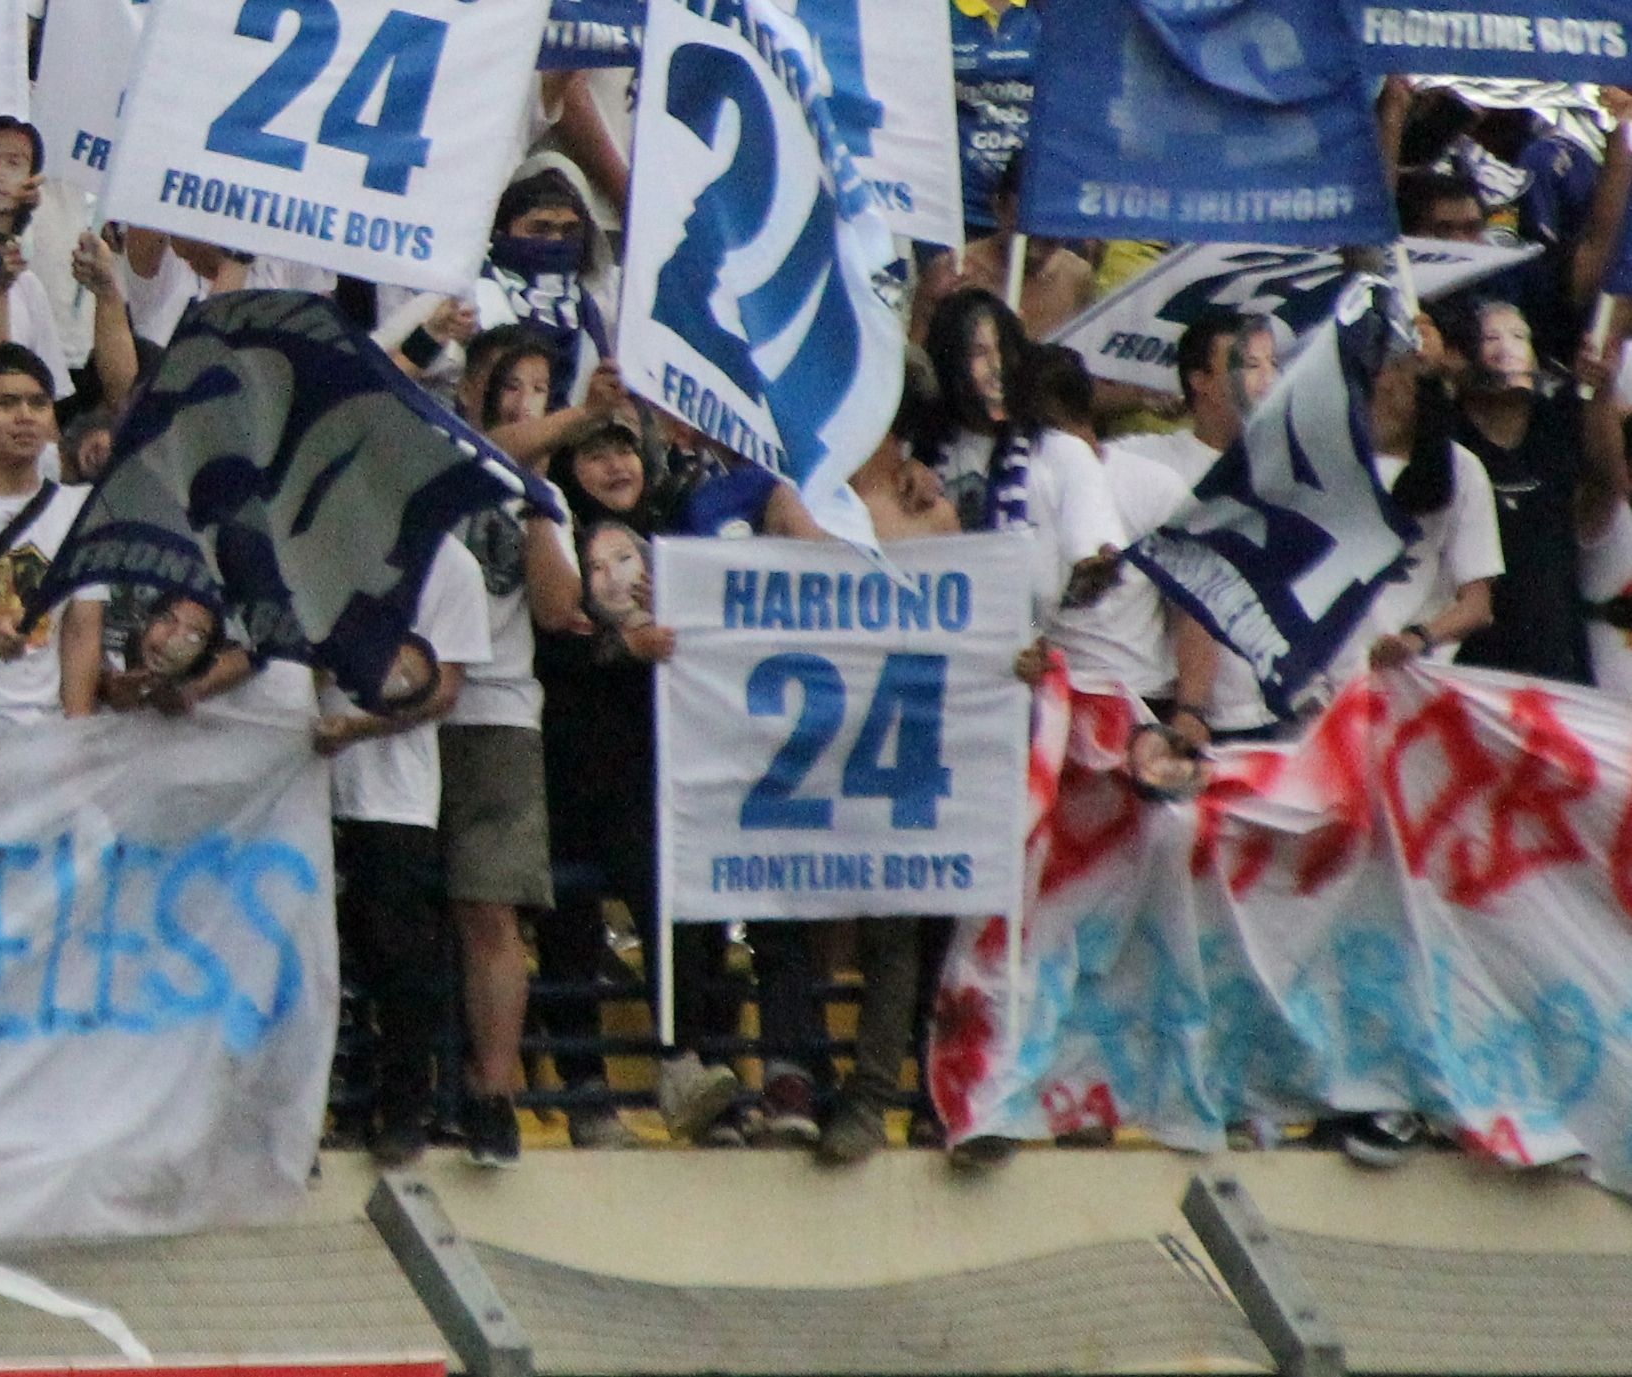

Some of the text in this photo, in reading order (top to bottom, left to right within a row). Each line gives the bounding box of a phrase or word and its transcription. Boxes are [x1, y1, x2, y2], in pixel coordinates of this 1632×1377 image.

[1362, 5, 1628, 58] FRONTLINE BOYS
[159, 168, 435, 263] FRONTLINE BOYS
[722, 568, 975, 633] HARIONO
[739, 651, 953, 831] 24
[711, 853, 975, 894] FRONTLINE BOYS
